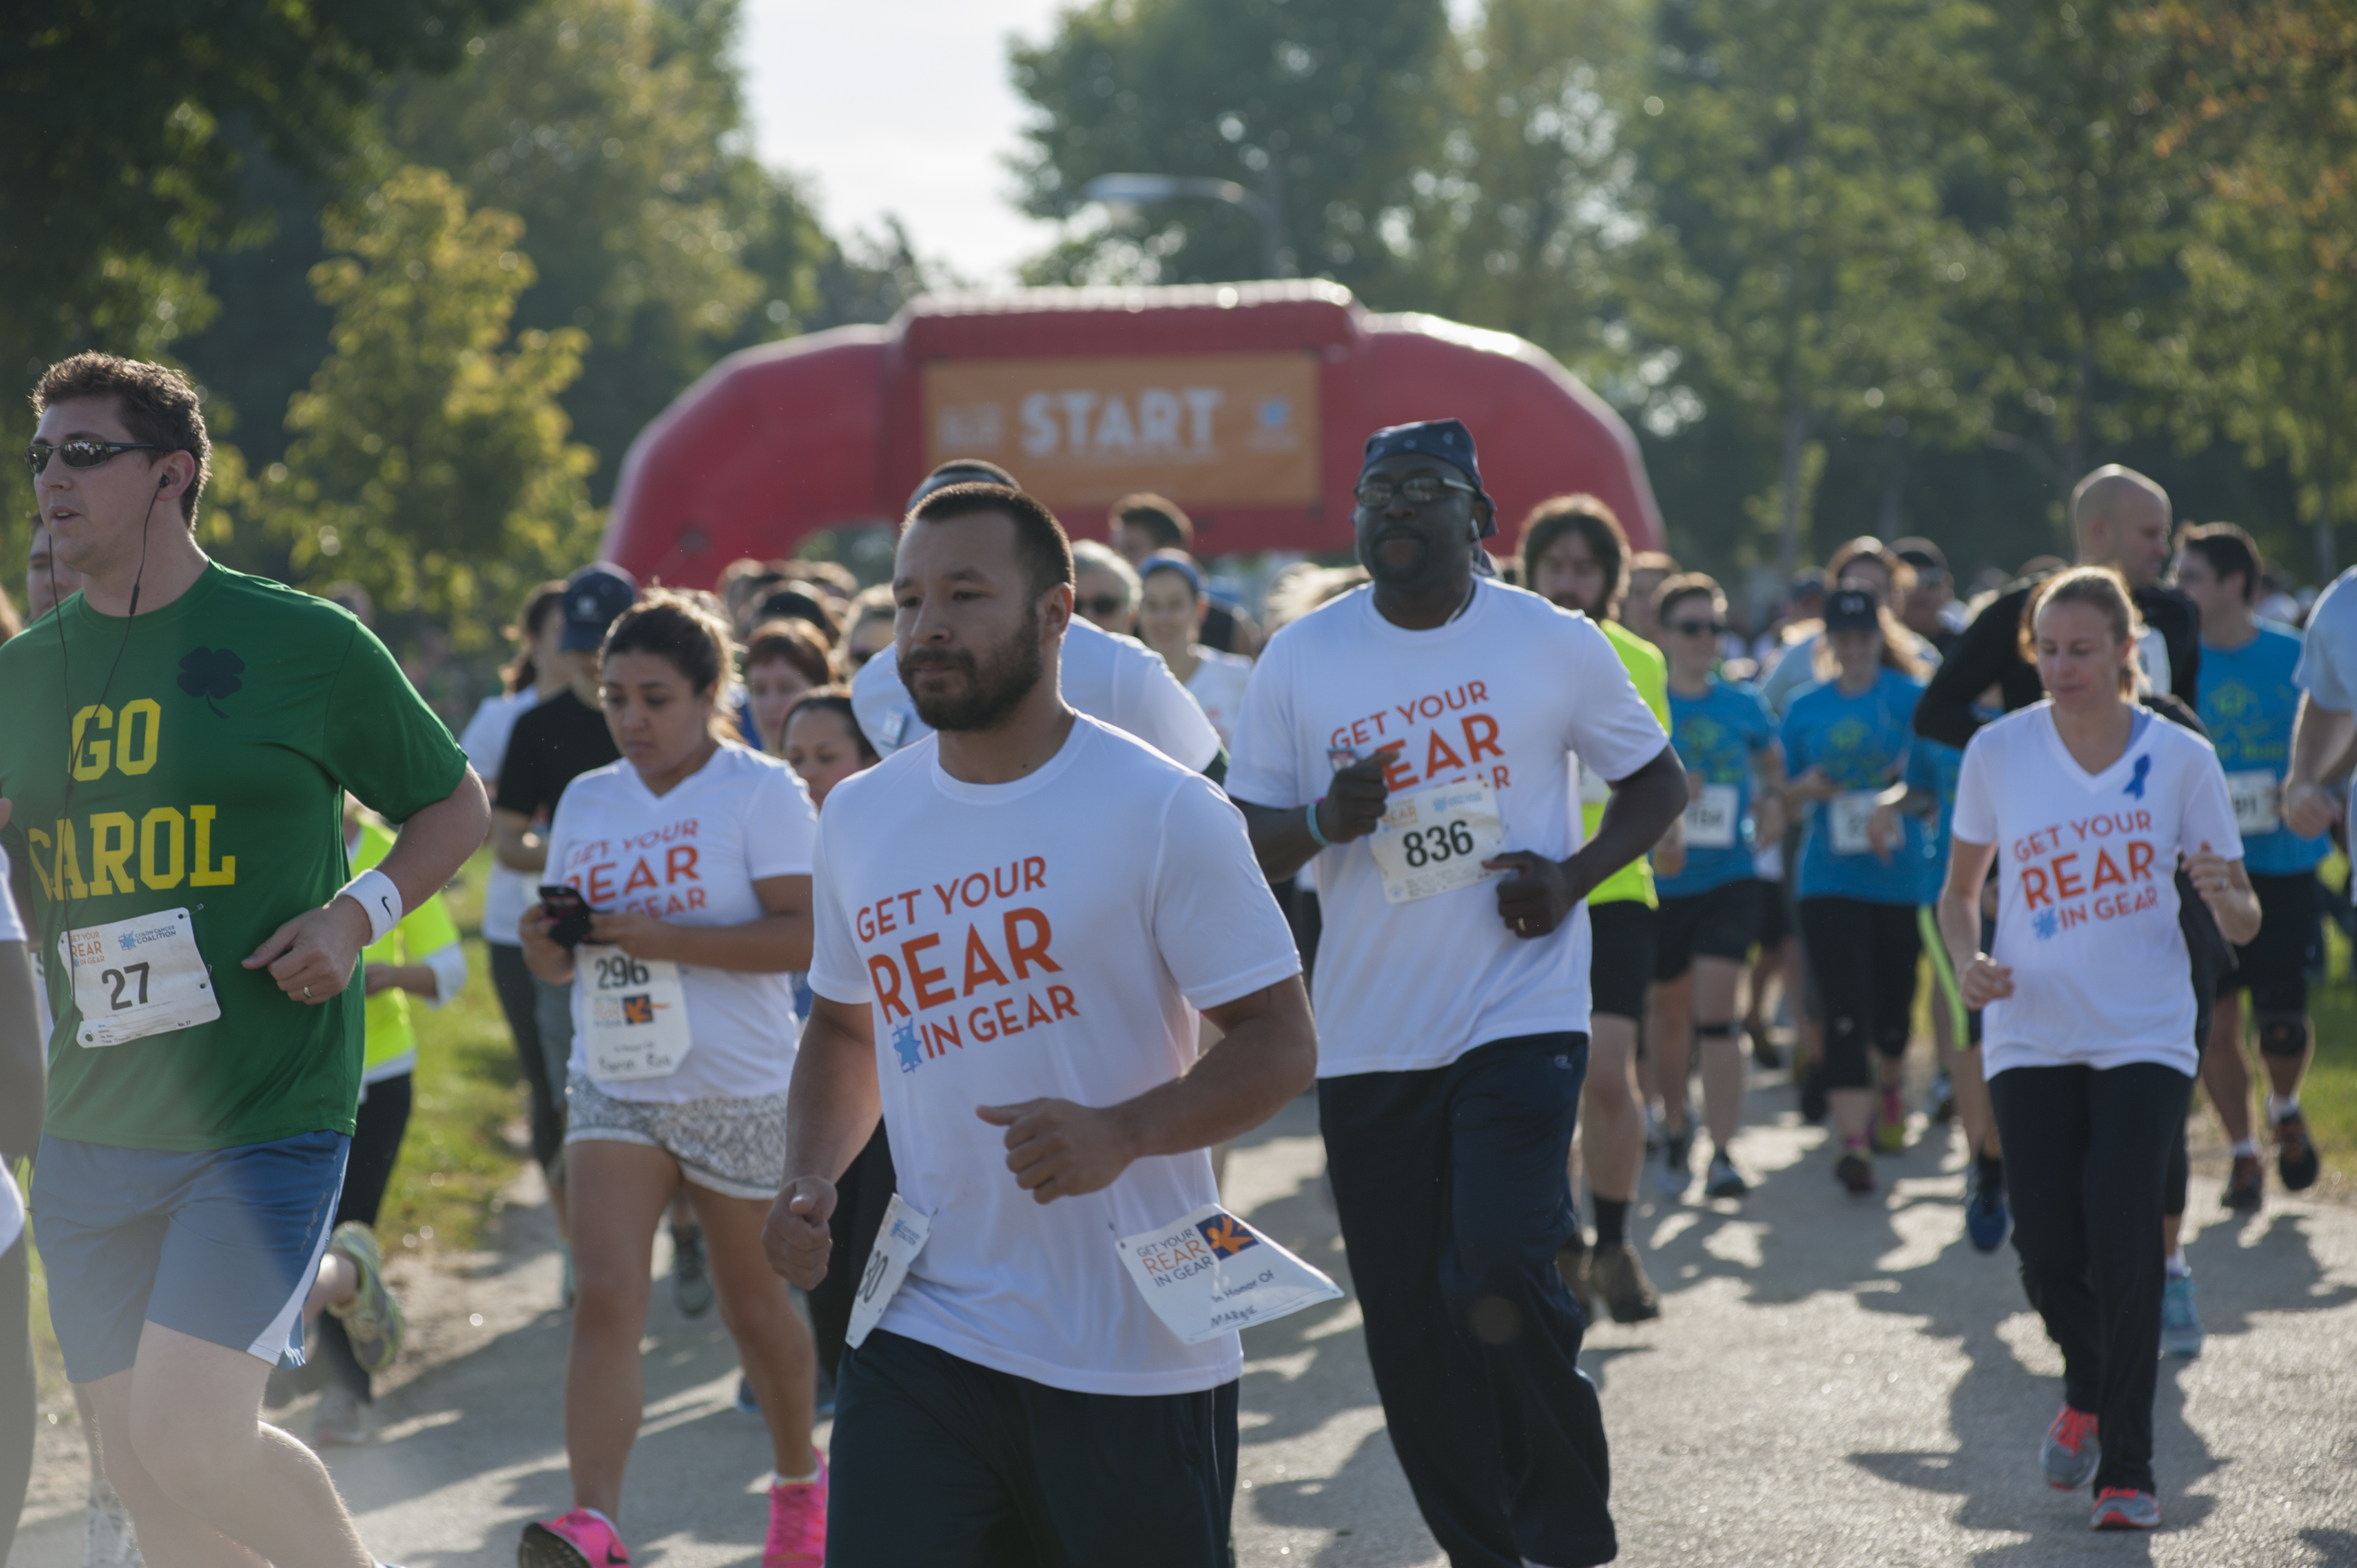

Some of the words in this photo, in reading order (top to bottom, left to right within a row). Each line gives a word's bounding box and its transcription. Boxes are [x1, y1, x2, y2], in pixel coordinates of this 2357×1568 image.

[1020, 387, 1223, 458] START
[1331, 711, 1387, 748] GET
[1396, 681, 1489, 726] YOUR
[68, 698, 162, 782] GO
[1373, 713, 1505, 793] EAR
[622, 817, 698, 851] YOUR
[1403, 819, 1474, 868] 836
[2014, 823, 2061, 862] GET
[2070, 809, 2152, 842] YOUR
[2021, 840, 2155, 911] REAR
[856, 889, 922, 943] GET
[933, 855, 1047, 916] YOUR
[2059, 902, 2088, 931] IN
[2093, 885, 2158, 921] GEAR
[71, 941, 103, 958] REAR
[83, 931, 100, 941] YOUR
[135, 930, 153, 938] COLON
[153, 925, 175, 934] CANCER
[137, 930, 177, 944] COALITION
[87, 955, 105, 964] GEAR
[595, 955, 650, 990] 296
[866, 907, 1064, 1026] REAR
[101, 961, 150, 1011] 27
[919, 1014, 964, 1060] IN
[967, 984, 1081, 1043] GEAR
[1136, 1242, 1159, 1258] GET
[1160, 1228, 1196, 1251] YOUR
[1141, 1239, 1208, 1276] REAR
[1152, 1273, 1172, 1288] IN
[1172, 1255, 1214, 1281] GEAR
[1223, 1280, 1257, 1299] Honor
[1258, 1268, 1275, 1283] Of
